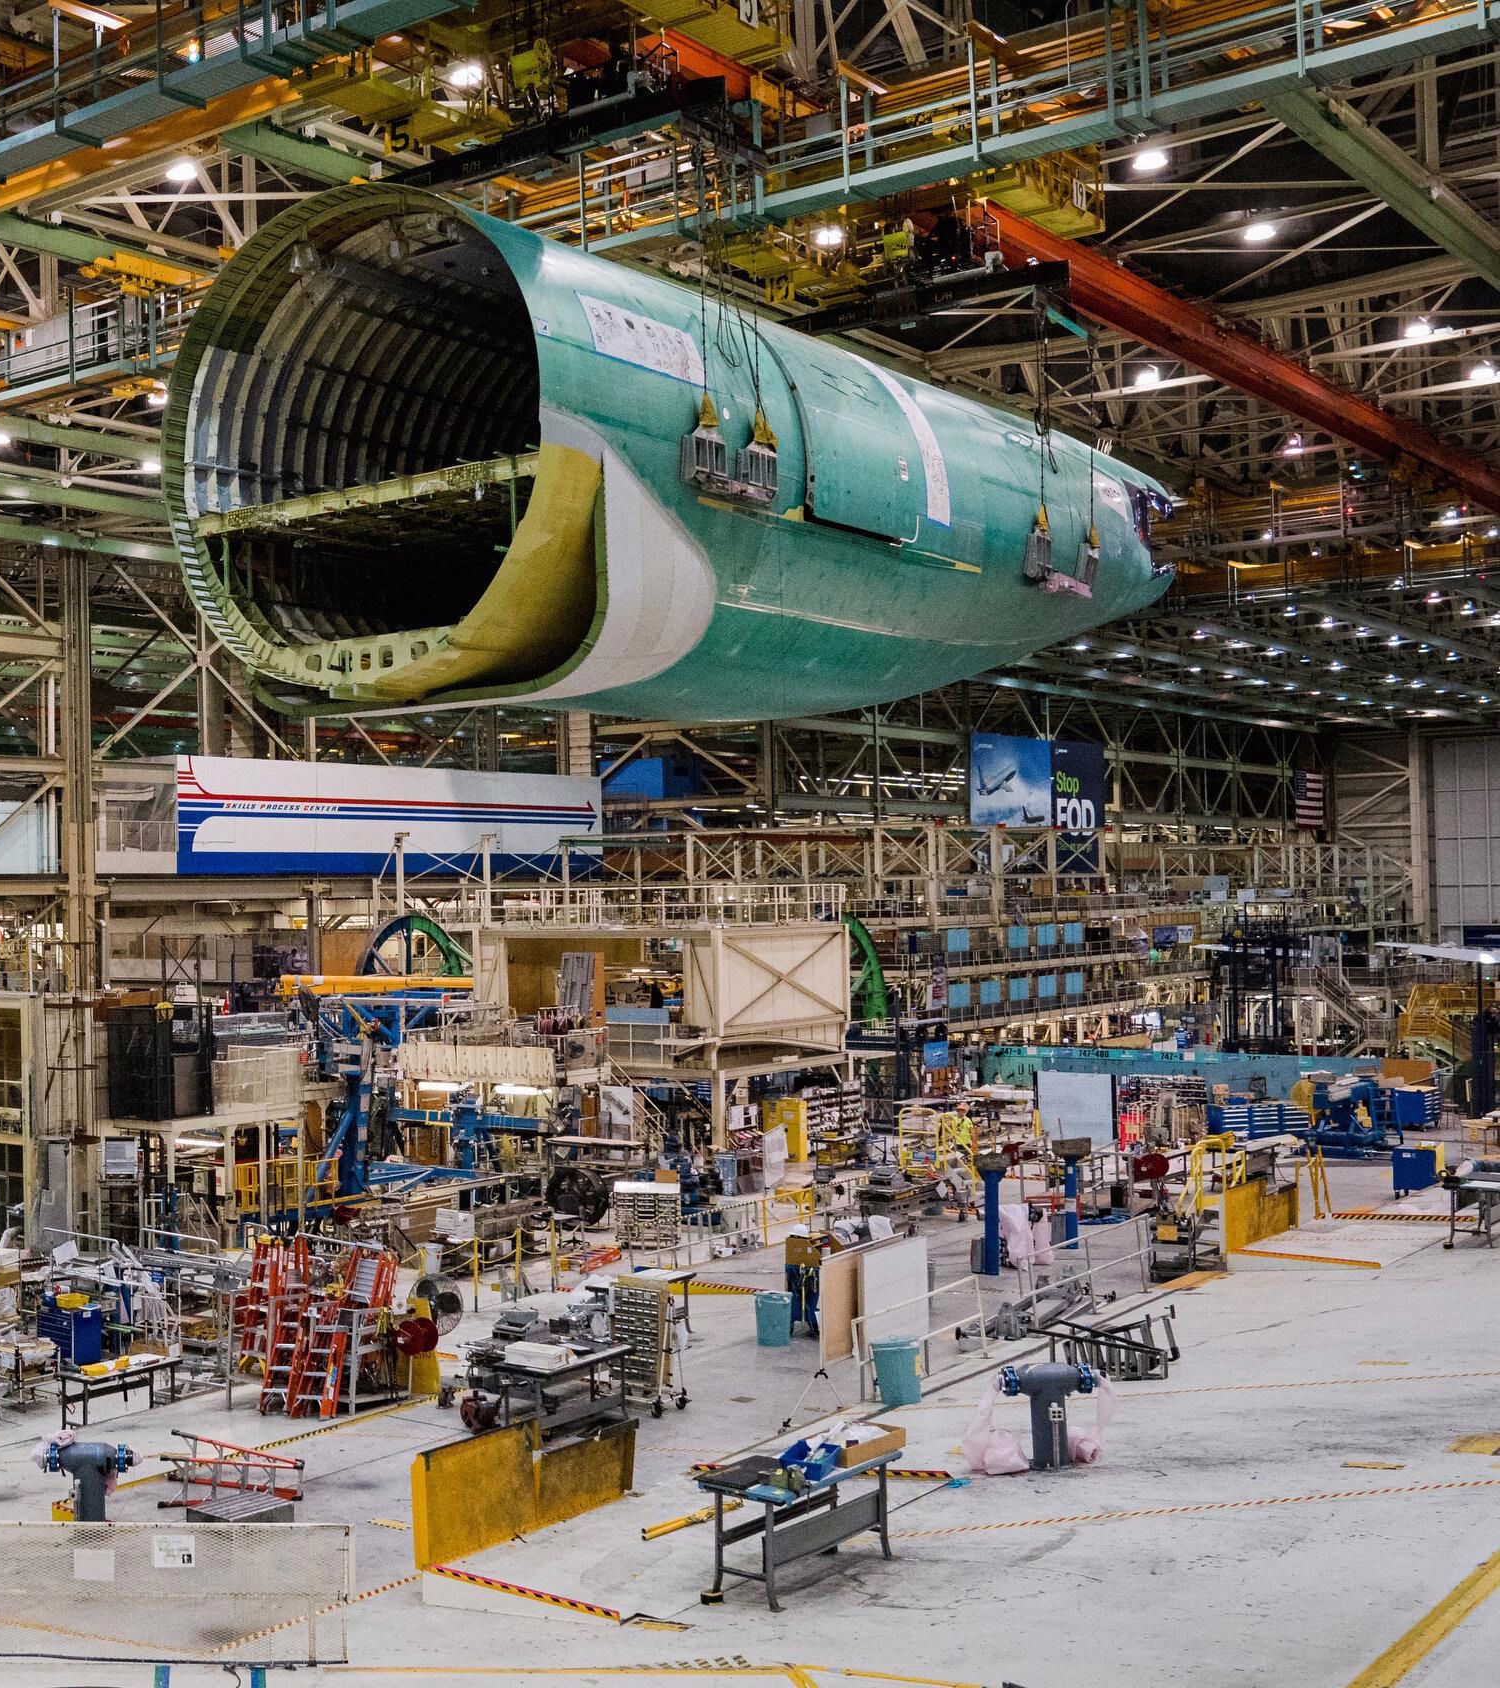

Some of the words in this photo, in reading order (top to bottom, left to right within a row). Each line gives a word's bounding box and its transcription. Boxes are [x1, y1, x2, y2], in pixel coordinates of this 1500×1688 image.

[1056, 770, 1079, 797] Stop
[224, 802, 256, 810] SKILLS
[259, 803, 301, 811] PROCESS
[1056, 797, 1096, 836] FOD
[1078, 1049, 1110, 1059] 747-400
[1160, 1052, 1184, 1061] 747-8
